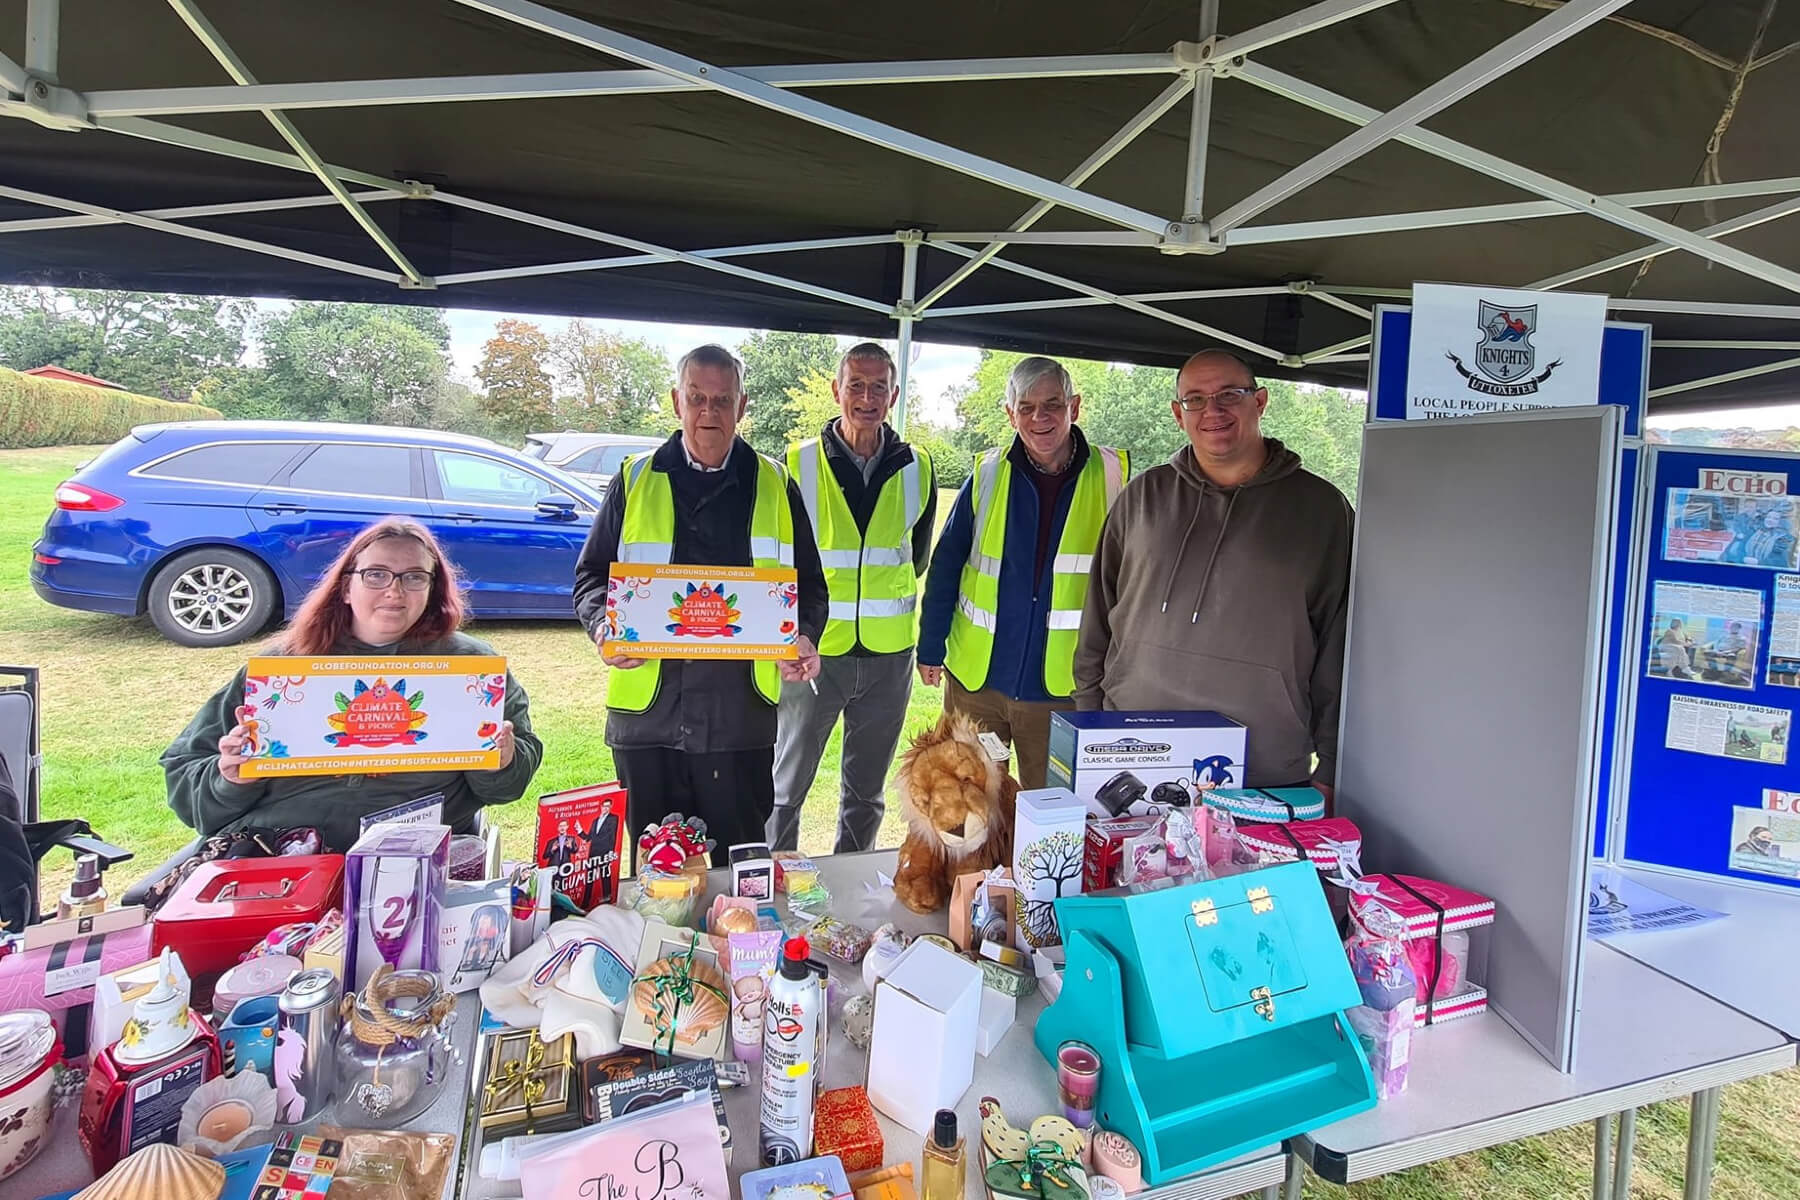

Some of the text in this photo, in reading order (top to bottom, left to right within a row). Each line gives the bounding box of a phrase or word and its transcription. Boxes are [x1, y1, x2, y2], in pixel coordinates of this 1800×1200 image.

[1482, 348, 1529, 365] KNIGHTS
[1499, 365, 1510, 377] 4
[1471, 378, 1536, 396] UTTOXETER
[1414, 397, 1458, 409] LOCAL
[1460, 399, 1510, 412] PEOPLE
[656, 568, 755, 577] GLOBEFOUNDATION.ORG.UK
[1778, 574, 1800, 583] Knig
[684, 601, 722, 609] CLIMATE
[682, 608, 727, 617] CARNIVAL
[311, 661, 450, 671] GLOBEFOUNDATION.ORG.UK
[351, 702, 403, 712] CLIMATE
[1672, 695, 1698, 704] RAISING
[1699, 698, 1737, 710] AWARENESS
[1747, 705, 1764, 714] ROAD
[347, 712, 409, 722] CARNIVAL
[368, 722, 396, 730] PICNIC
[1083, 756, 1114, 764] CLASSIC
[1138, 755, 1171, 763] CONSOLE
[554, 863, 612, 892] RGUMENTS
[613, 1075, 647, 1091] Double
[647, 1068, 677, 1083] Sided
[676, 1059, 714, 1079] Scented
[687, 1073, 716, 1092] Soap
[578, 1172, 628, 1200] The
